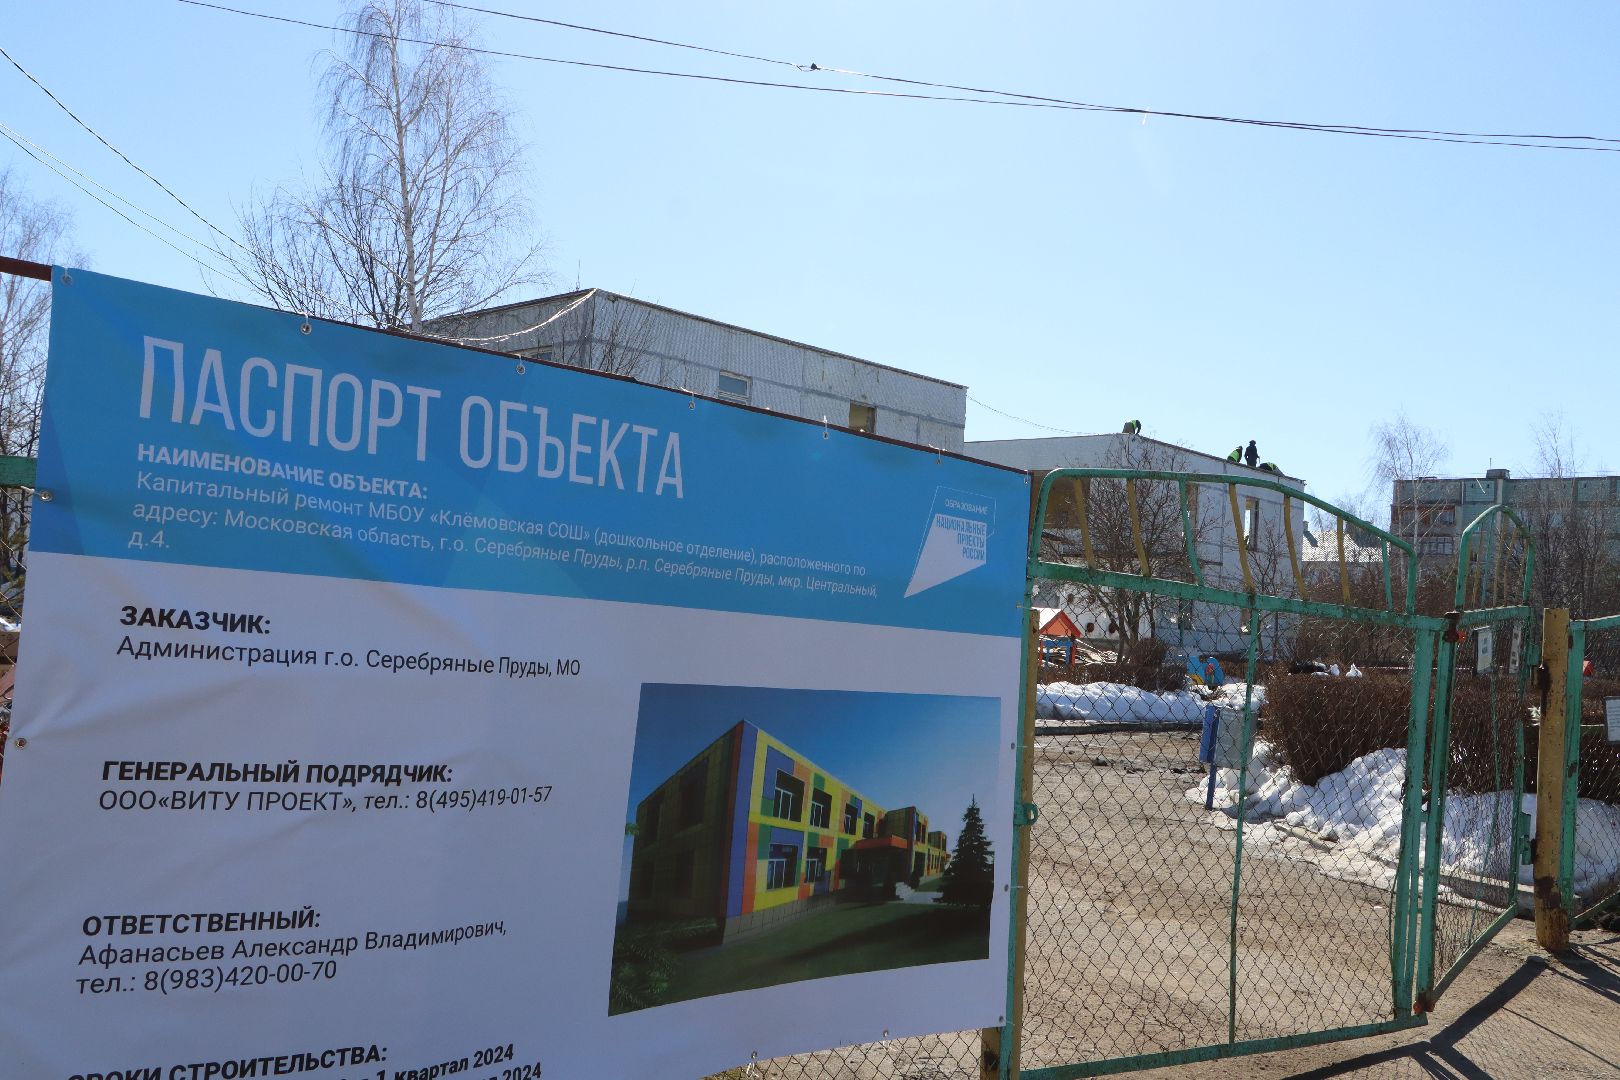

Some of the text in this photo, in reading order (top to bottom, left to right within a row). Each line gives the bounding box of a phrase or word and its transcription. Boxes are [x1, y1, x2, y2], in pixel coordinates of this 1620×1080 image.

[139, 335, 684, 499] ПАСПОРТ ОБЪЕКТА
[138, 443, 428, 500] НАИМЕНОВАНИЕ ОБЪЕКТА:
[944, 498, 989, 515] ОБРАЗОВАНИЕ
[128, 530, 170, 549] д.4.
[137, 471, 866, 577] Капитальный ремонт МБОУ «Клёмовская СОШ» (дошкольное отделение), расположенного по
[936, 515, 986, 536] НАЦИОНАЛЬНЫЕ
[957, 533, 985, 549] ПРОЕКТЫ
[133, 503, 878, 598] адресу: Московская область, г.о. Серебряные Пруды, р.п. Серебряные Пруды, мкр. Центральный,
[962, 547, 985, 560] РОССИИ
[120, 605, 271, 634] ЗАКАЗЧИК:
[117, 636, 581, 678] Администрация г.о. Серебряные Пруды, МО
[102, 759, 453, 788] ГЕНЕРАЛЬНЫЙ ПОДРЯДЧИК:
[99, 786, 553, 813] ООО«ВИТУ ПРОЕКТ», тел.: 8(495)419-01-57
[82, 905, 321, 937] ОТВЕТСТВЕННЫЙ:
[78, 920, 507, 970] Афанасьев Александр Владимирович,
[76, 960, 337, 996] тел.: 8(983)420-00-70
[168, 1044, 388, 1080] СТРОИТЕЛЬСТВА:
[394, 1057, 469, 1080] квартал
[473, 1043, 514, 1069] 2024
